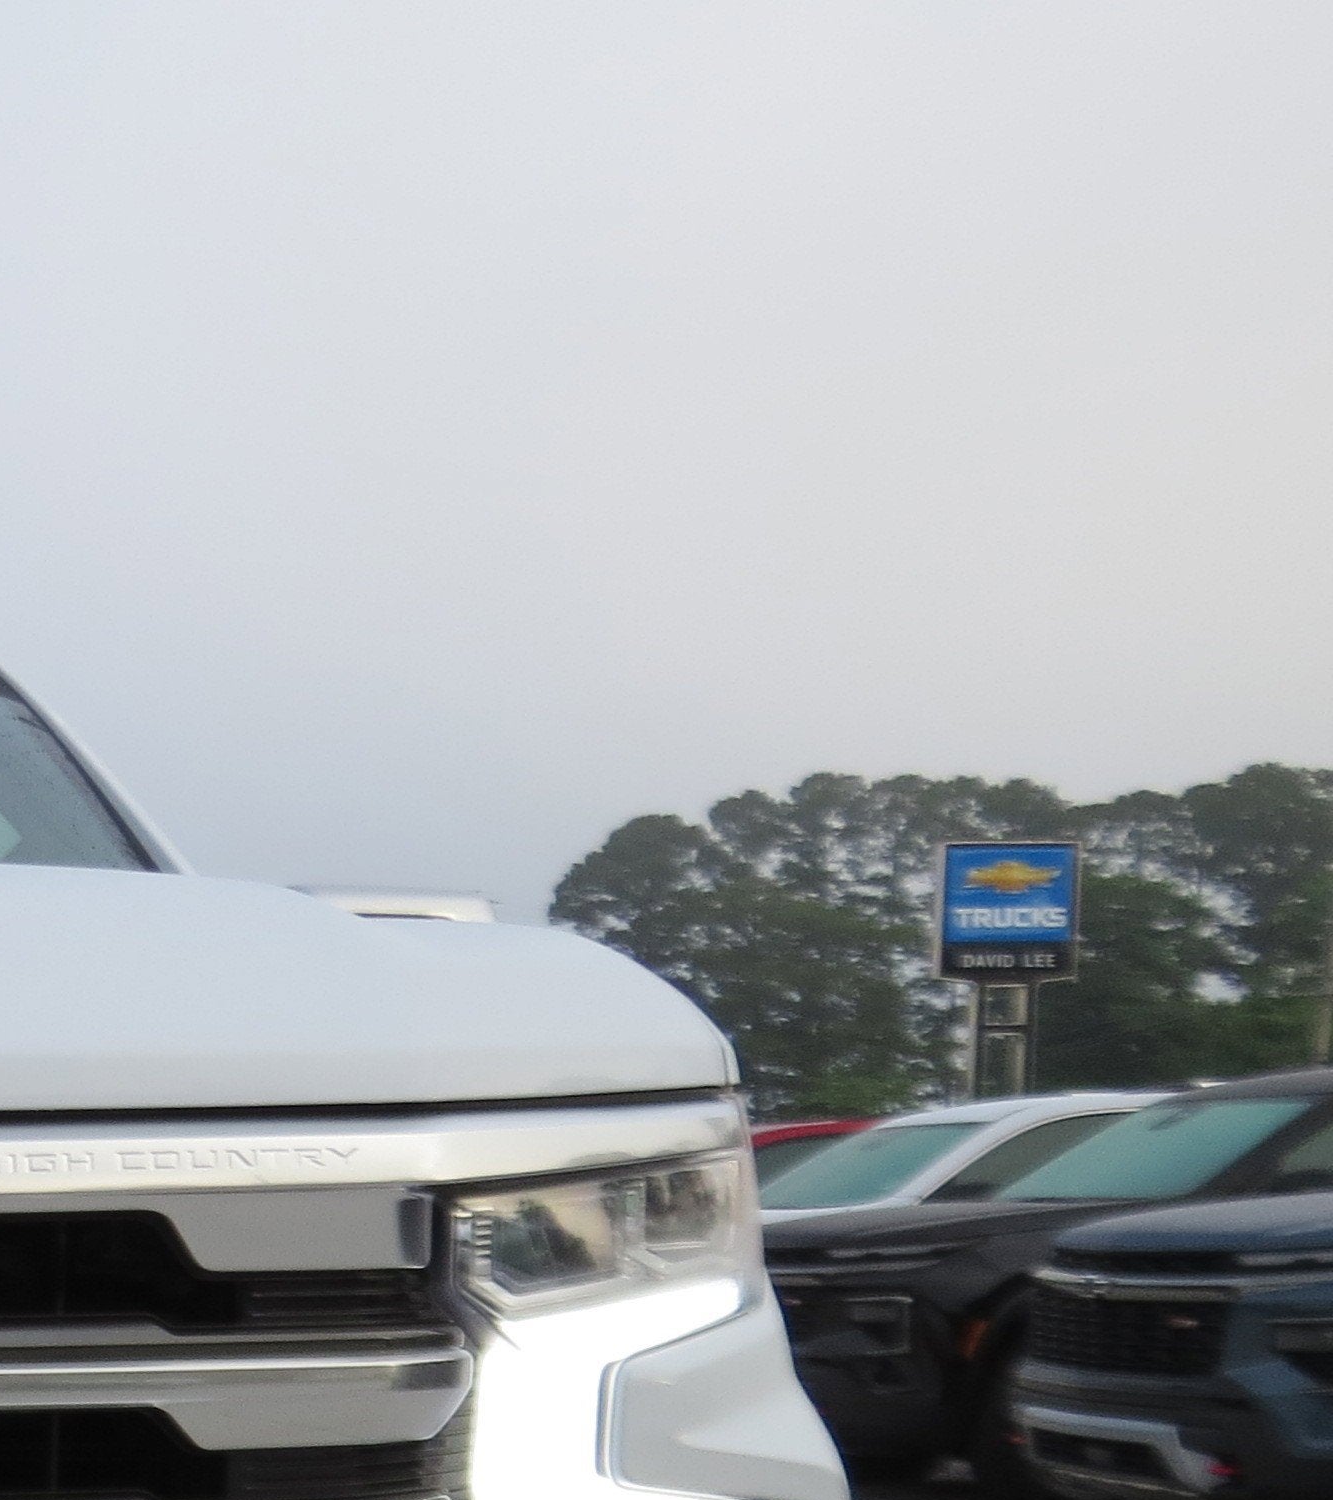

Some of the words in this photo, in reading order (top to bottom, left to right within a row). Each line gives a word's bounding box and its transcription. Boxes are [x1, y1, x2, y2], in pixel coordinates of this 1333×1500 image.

[952, 907, 1068, 929] TRUCKS
[963, 954, 1015, 969] DAVID
[1024, 954, 1056, 968] LEE
[115, 1147, 359, 1172] COUNTRY
